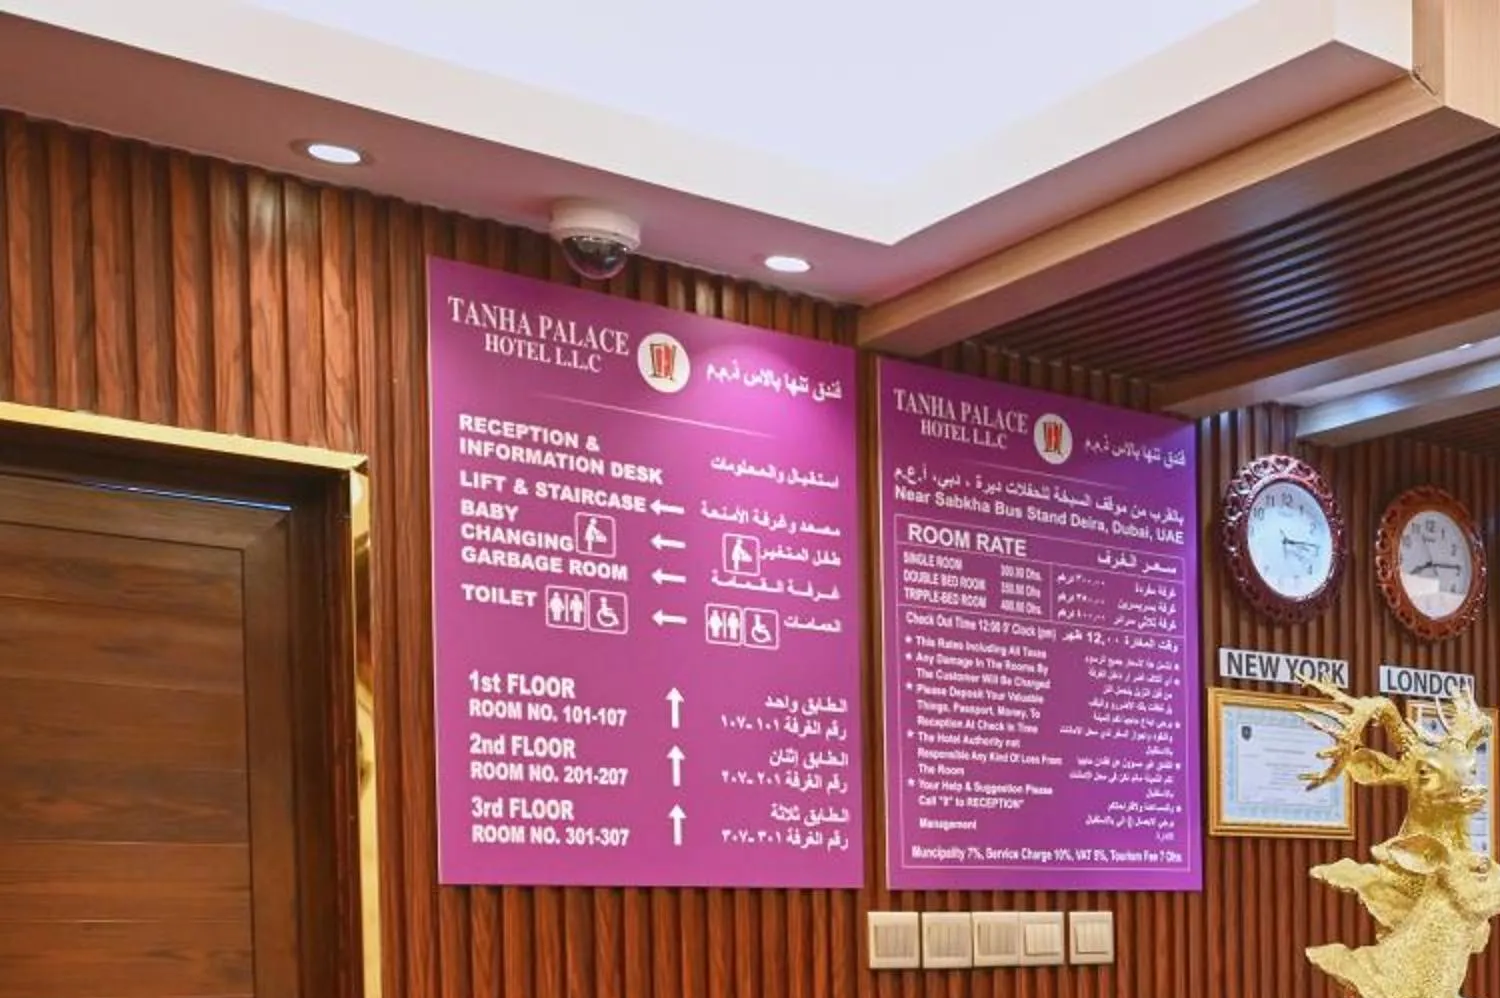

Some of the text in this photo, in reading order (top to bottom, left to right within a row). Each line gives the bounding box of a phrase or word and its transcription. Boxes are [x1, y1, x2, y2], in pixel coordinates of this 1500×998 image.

[447, 296, 630, 355] TANHA PALACE
[484, 333, 602, 373] HOTEL L.L.C
[894, 388, 1029, 434] TANHA PALACE
[459, 413, 600, 451] RECEPTION &
[921, 419, 970, 443] HOTEL
[459, 438, 663, 485] INFORMATION DESK
[460, 470, 646, 512] LIFT & STAIRCASE
[460, 499, 519, 522] BABY
[895, 485, 930, 505] Near
[935, 491, 990, 513] Sabkha
[995, 500, 1023, 518] Bus
[1027, 507, 1067, 525] Stand
[1112, 520, 1153, 541] Dubai,
[1156, 528, 1184, 544] UAE
[460, 523, 574, 552] CHANGING
[908, 523, 1027, 557] ROOM RATE
[461, 546, 628, 581] GARBAGE ROOM
[461, 583, 537, 607] TOILET
[469, 669, 576, 699] 1st FLOOR
[1227, 651, 1345, 685] NEW YORK
[469, 698, 627, 727] ROOM NO. 101-107
[469, 733, 576, 759] 2nd FLOOR
[470, 761, 628, 786] ROOM NO. 201-207
[471, 796, 574, 821] 3rd FLOOR
[472, 824, 630, 847] ROOM NO. 301-307
